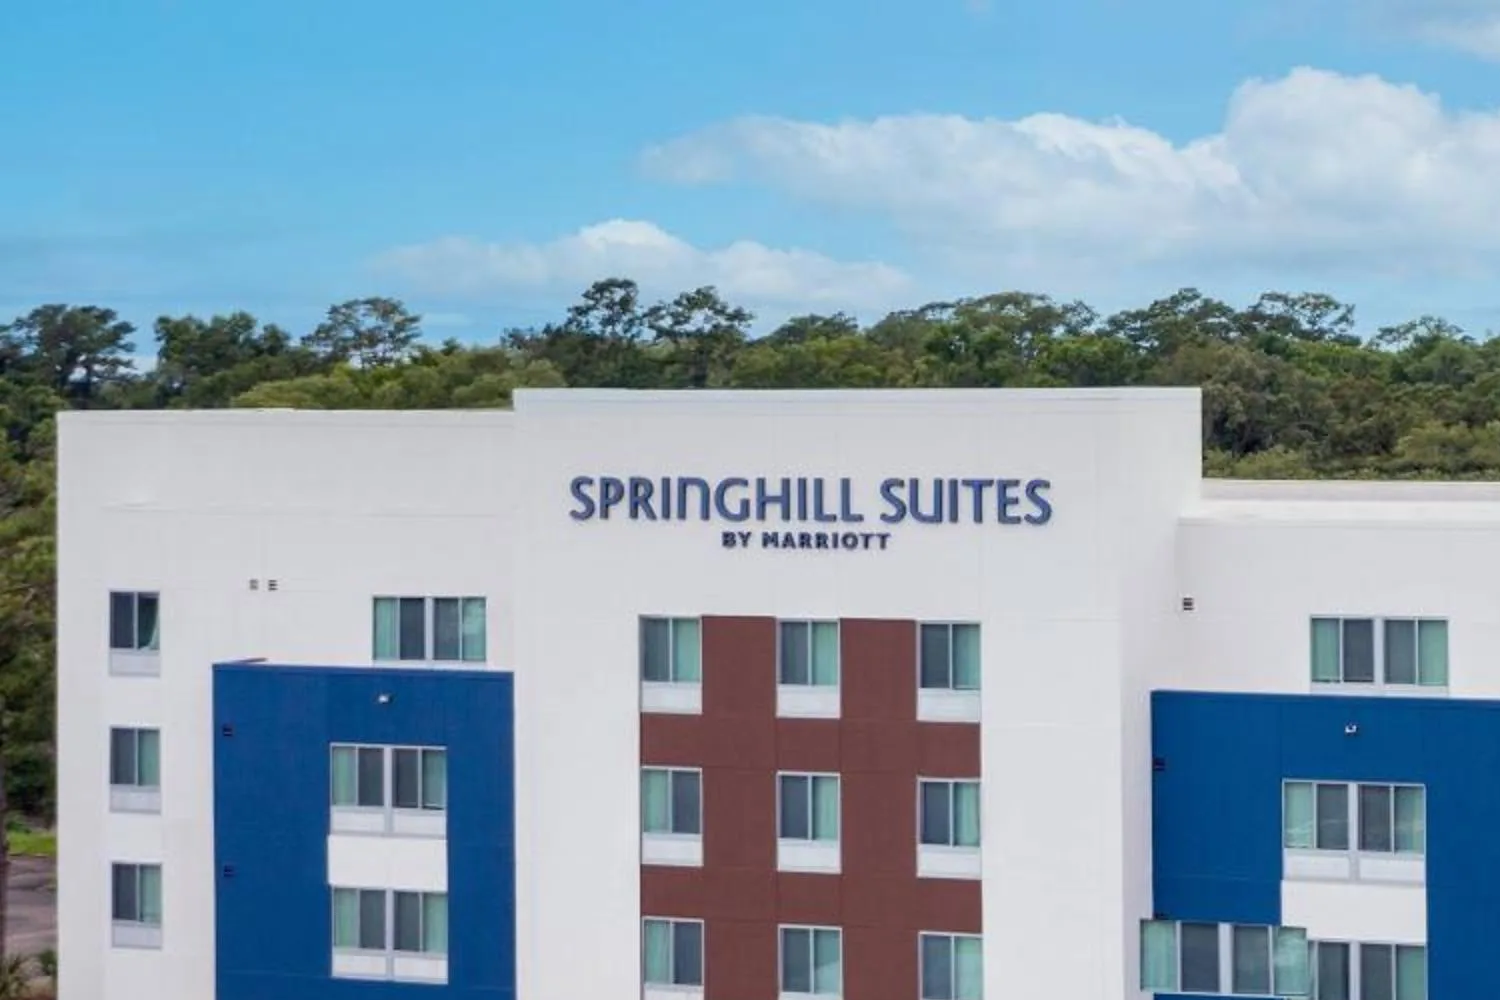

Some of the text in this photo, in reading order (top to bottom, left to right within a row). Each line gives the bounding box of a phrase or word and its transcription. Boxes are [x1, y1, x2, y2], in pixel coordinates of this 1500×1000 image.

[569, 475, 1053, 526] SPRINGHILL SUITES
[721, 530, 891, 551] BY MARRIOTT
